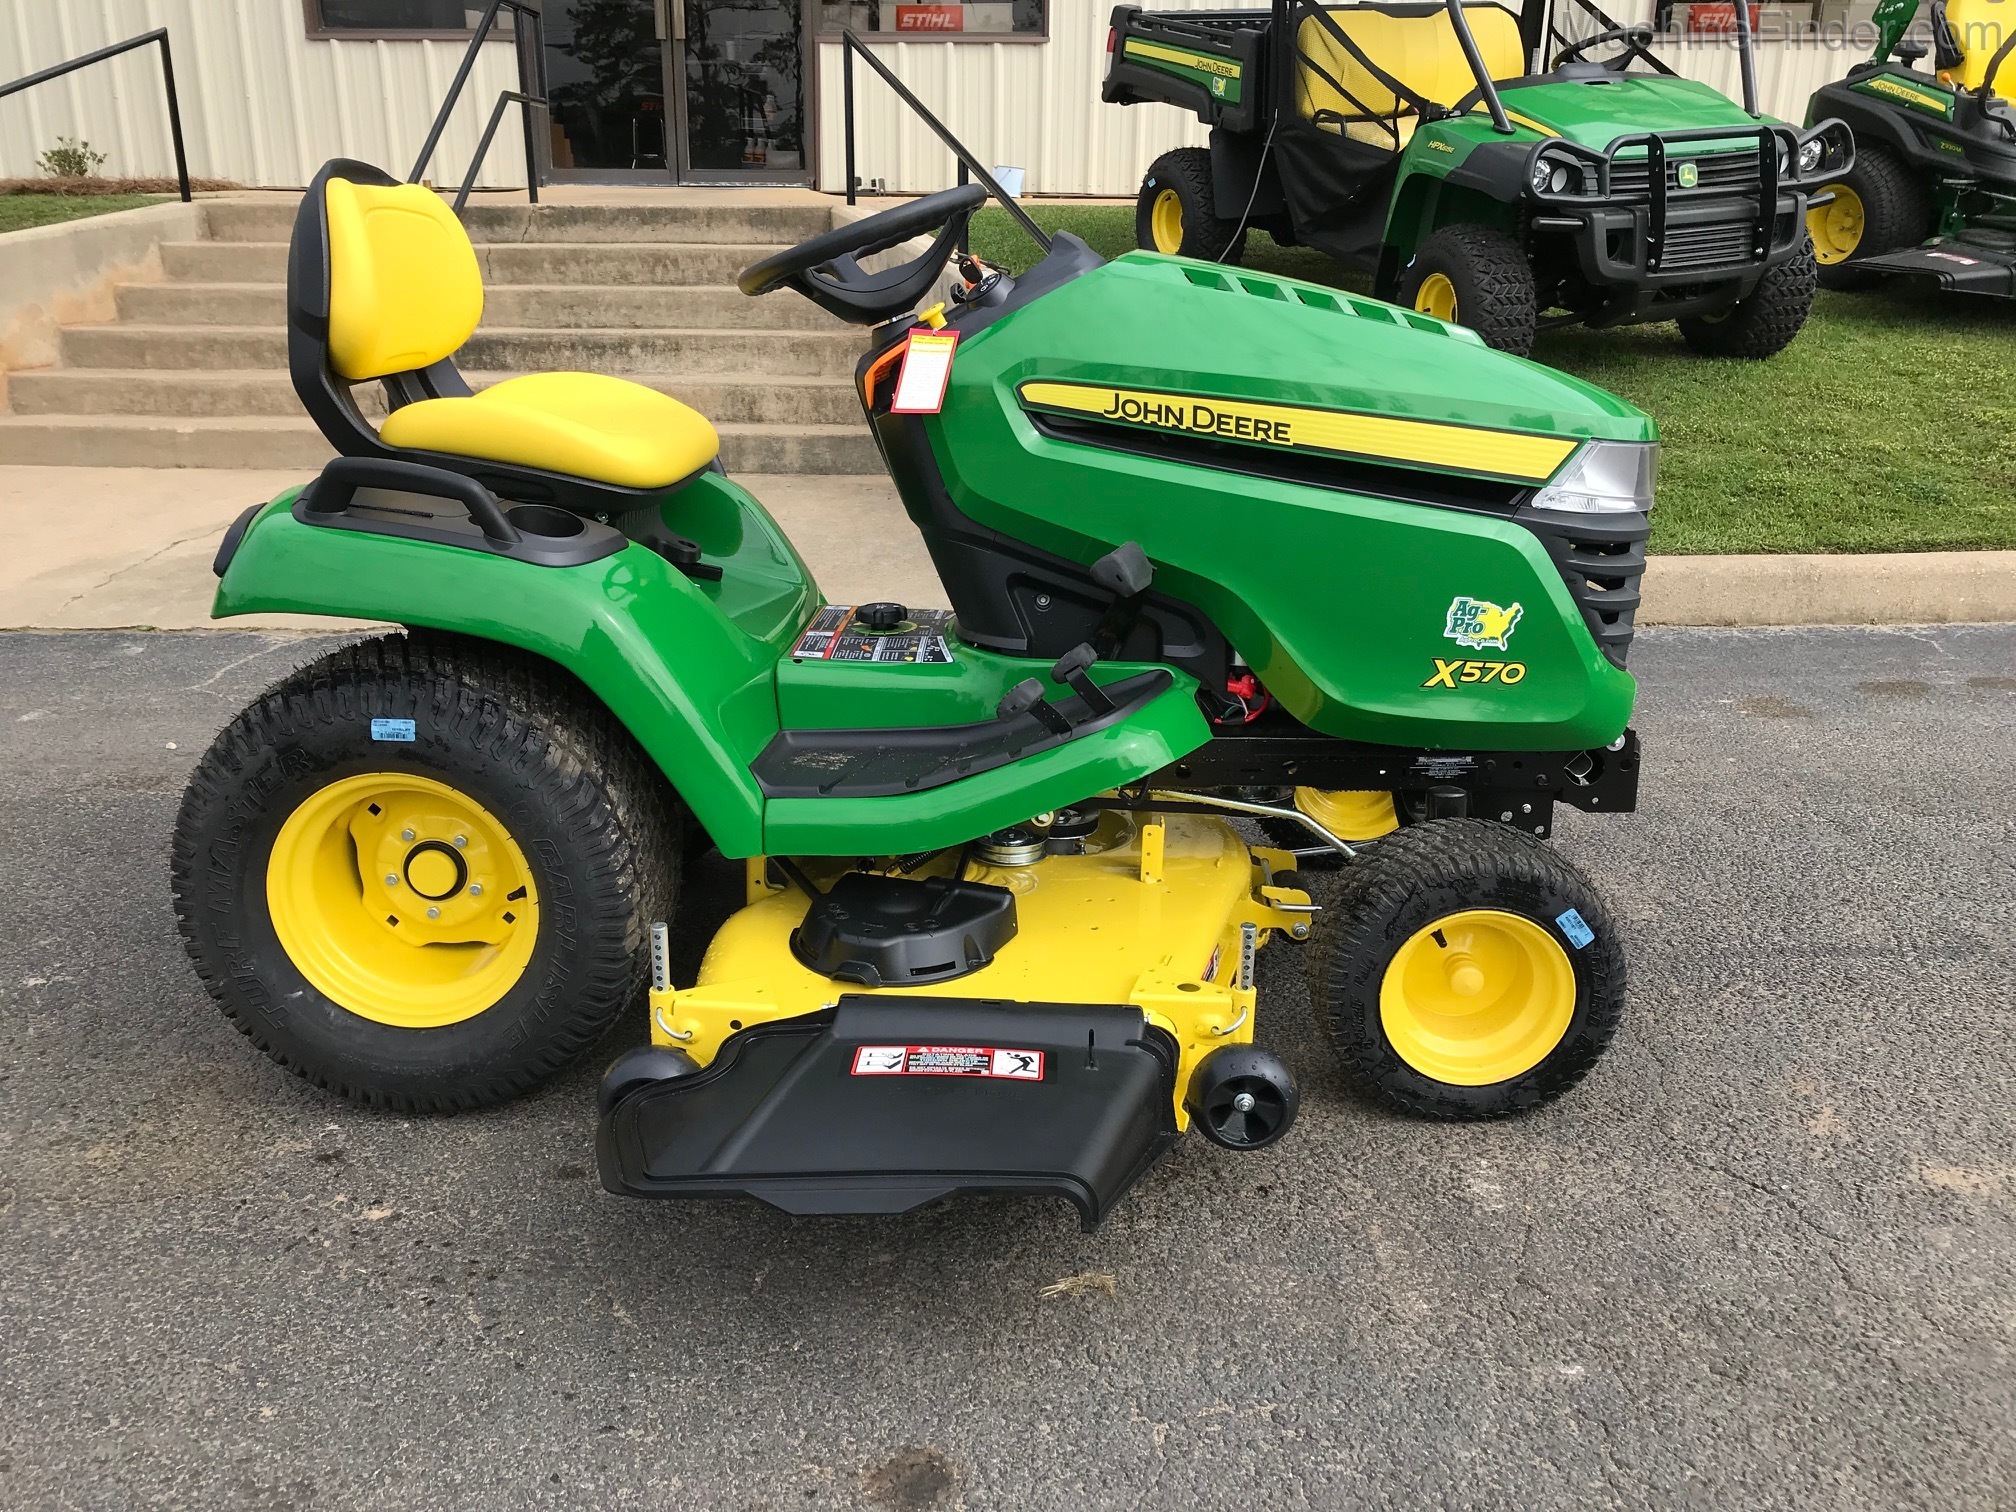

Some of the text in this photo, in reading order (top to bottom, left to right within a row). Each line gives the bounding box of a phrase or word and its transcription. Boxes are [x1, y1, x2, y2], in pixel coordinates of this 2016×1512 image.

[901, 13, 955, 28] STIHL
[1195, 58, 1233, 77] JOHN DEERE
[1877, 81, 1920, 101] JOHN DEERE
[1104, 393, 1292, 443] JOHN DEERE
[1449, 617, 1484, 634] Pro
[1420, 658, 1527, 689] X570
[501, 838, 578, 1051] CARLISLE
[211, 922, 290, 1030] TURF
[931, 1046, 984, 1054] DANGER
